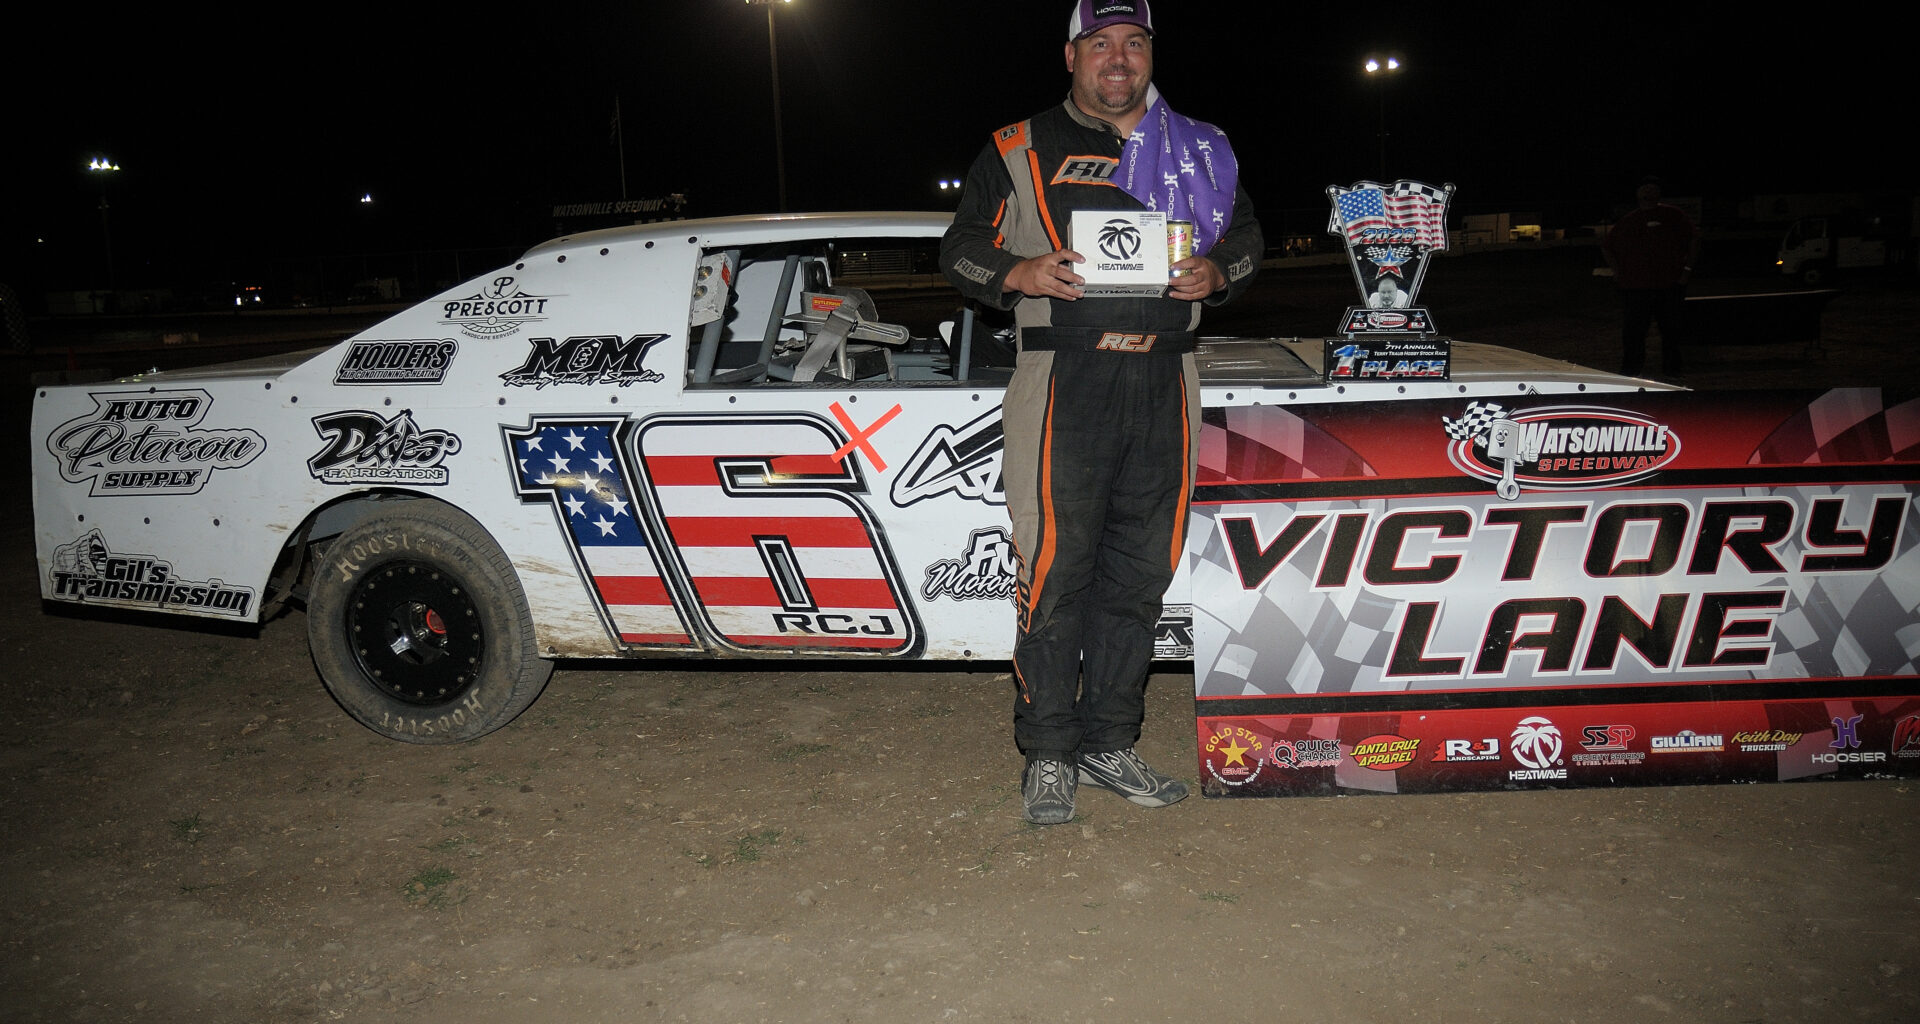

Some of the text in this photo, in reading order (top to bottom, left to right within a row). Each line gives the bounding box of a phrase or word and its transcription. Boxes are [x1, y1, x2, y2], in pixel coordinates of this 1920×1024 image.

[1096, 6, 1134, 15] HOOSIER
[1127, 144, 1138, 190] HOOSIER
[553, 199, 663, 217] WATSONVILLE SPEEDWAY
[1361, 228, 1417, 245] 2026
[1097, 263, 1144, 271] HEATWAVE
[444, 299, 548, 318] PRESCOTT
[461, 329, 491, 340] LANDSCAPE
[1096, 332, 1157, 352] RCJ
[344, 342, 454, 370] HOLDERS
[498, 334, 671, 378] M&M
[340, 370, 354, 378] AIR
[355, 370, 404, 378] CONDITIONING
[411, 370, 440, 378] HEATING
[1360, 360, 1446, 377] PLACE
[102, 398, 201, 422] AUTO
[1518, 423, 1669, 454] WATSONVILLE
[56, 421, 257, 475] Peterson
[1537, 456, 1664, 471] SPEEDWAY
[102, 469, 203, 490] SUPPLY
[498, 412, 926, 659] 16
[1216, 495, 1910, 590] VICTORY
[105, 559, 168, 584] Gil's
[54, 572, 252, 611] Transmission
[772, 613, 895, 635] RCJ
[1381, 590, 1788, 679] LANE
[1205, 727, 1262, 752] GOLD STAR
[1295, 740, 1341, 751] QUICK
[1446, 738, 1499, 755] R&J
[1651, 735, 1723, 748] GIULIANI
[1731, 730, 1802, 746] Keith Day
[1298, 752, 1340, 760] CHANGE
[1350, 739, 1421, 756] SANTA CRUZ
[1741, 744, 1786, 752] TRUCKING
[1358, 754, 1413, 767] APPAREL
[1572, 752, 1646, 761] SECURITY SHORING
[1812, 752, 1886, 763] HOOSIER
[1222, 767, 1249, 775] GMC
[1509, 769, 1567, 780] HEATWAVE
